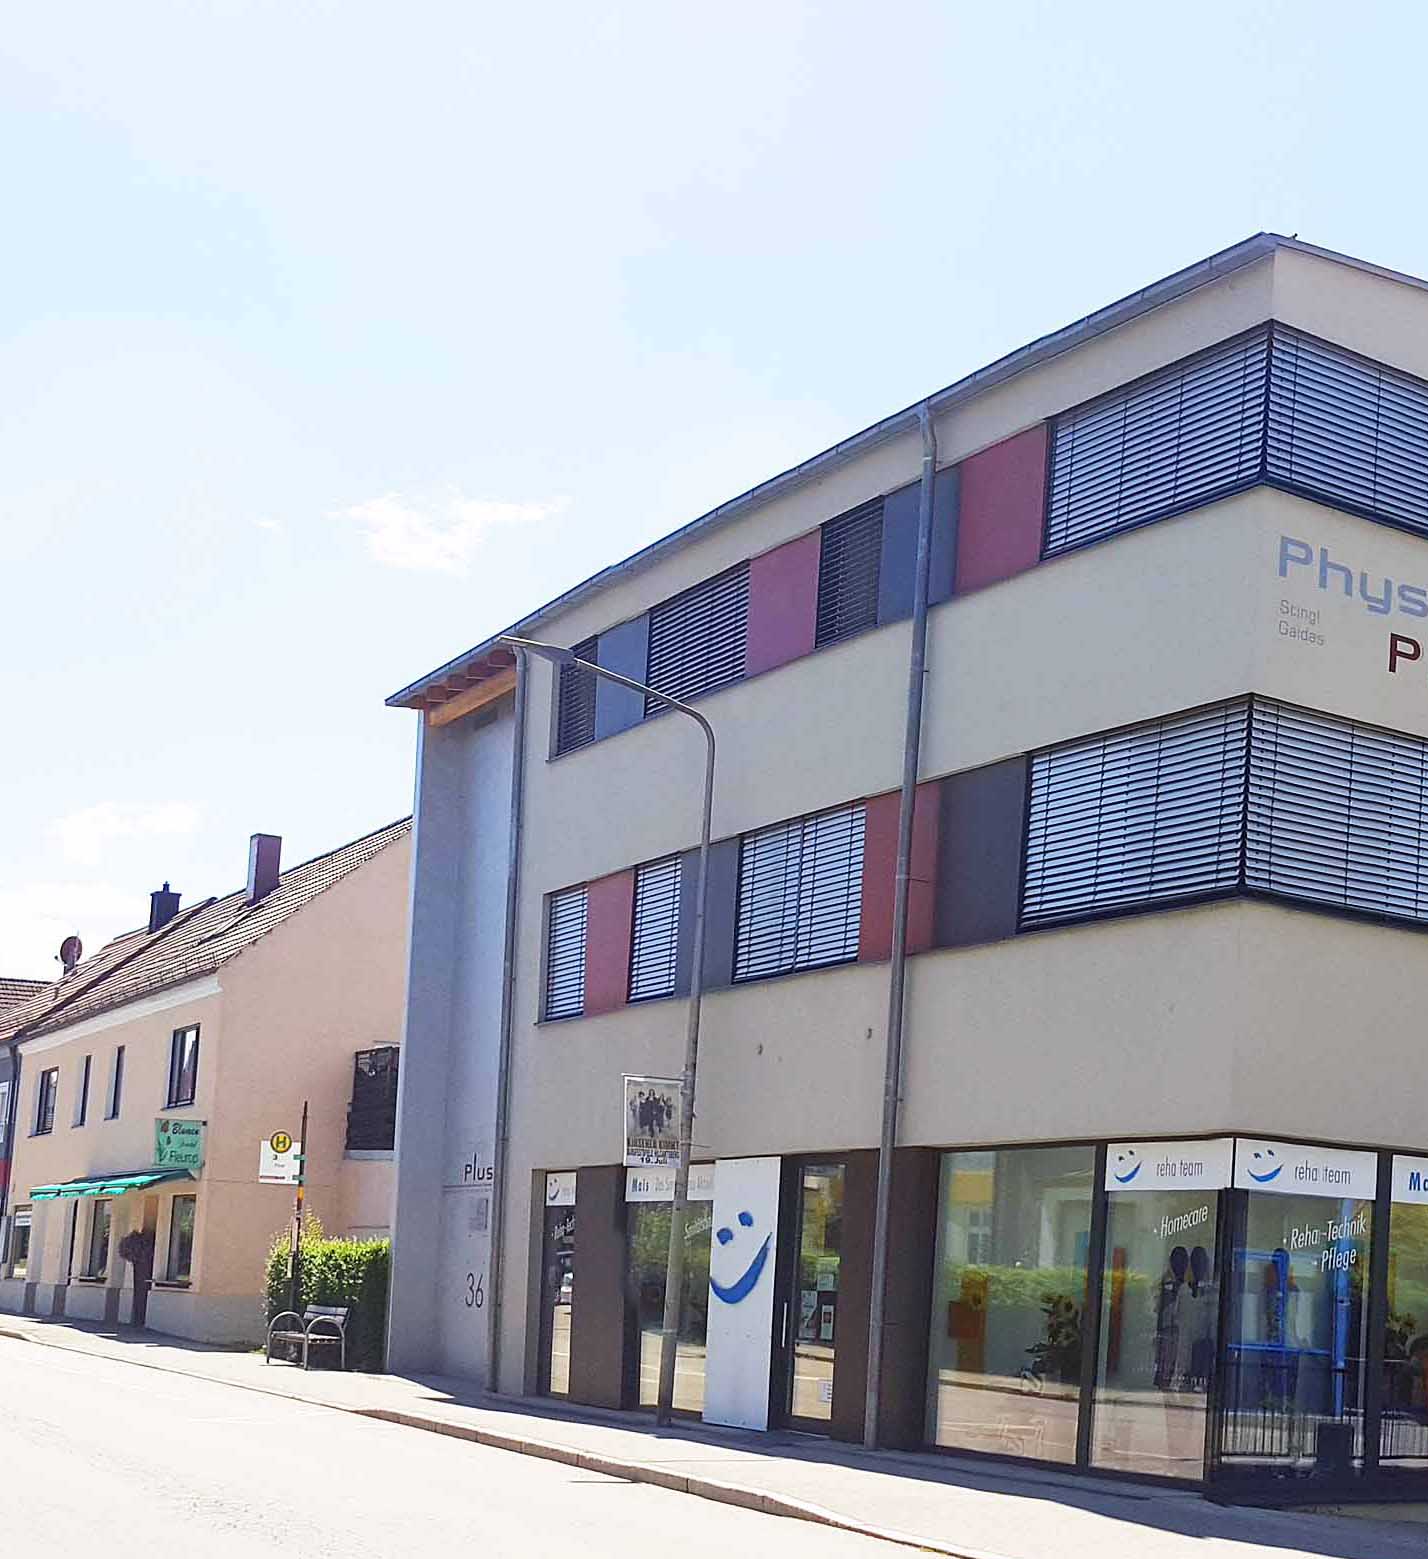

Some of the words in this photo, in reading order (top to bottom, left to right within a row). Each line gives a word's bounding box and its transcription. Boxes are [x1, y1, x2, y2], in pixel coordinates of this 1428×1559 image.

[1279, 599, 1320, 626] Stingl
[276, 1135, 287, 1149] H
[464, 1152, 493, 1182] Plus
[1156, 1158, 1177, 1177] reha
[1180, 1160, 1203, 1177] team
[1294, 1160, 1318, 1182] reha
[1322, 1166, 1351, 1184] team
[1160, 1204, 1209, 1240] Homecare
[1321, 1247, 1357, 1273] Pflege
[465, 1272, 484, 1308] 36
